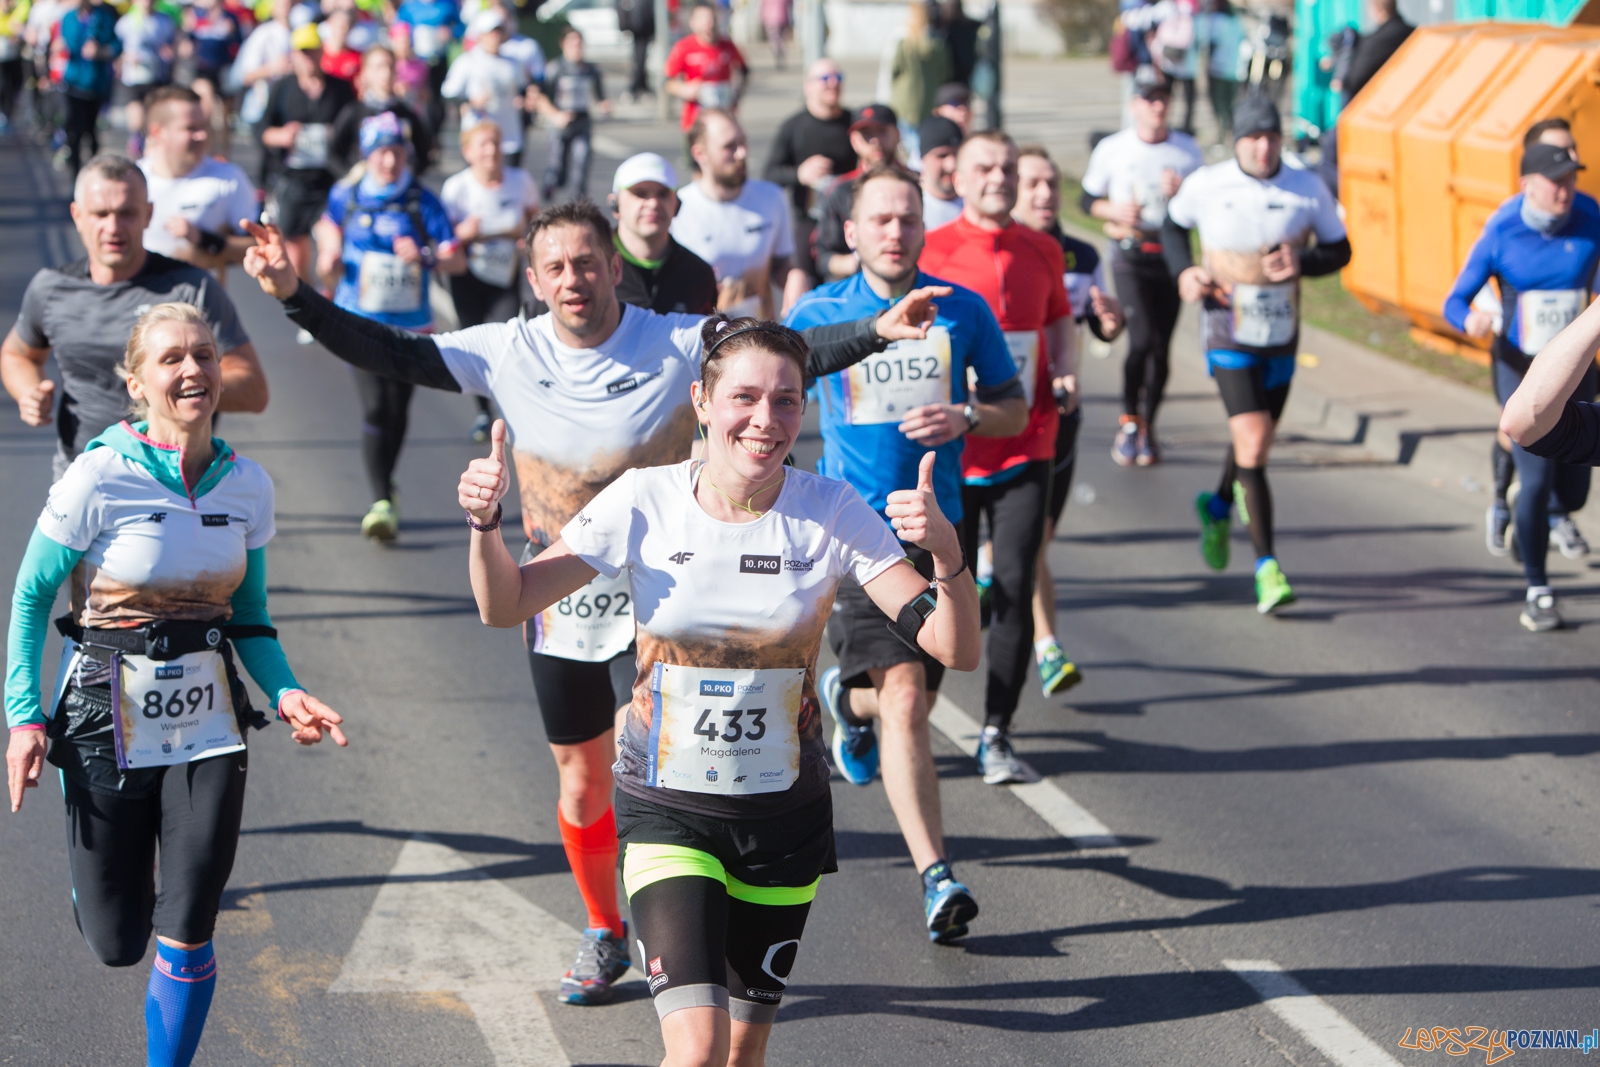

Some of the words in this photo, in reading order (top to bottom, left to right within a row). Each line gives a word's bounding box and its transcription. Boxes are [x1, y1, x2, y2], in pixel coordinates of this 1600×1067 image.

[861, 356, 940, 384] 10152
[668, 551, 695, 565] 4F
[744, 559, 756, 569] 10.
[757, 560, 778, 570] PKO
[558, 591, 630, 618] 8692
[167, 667, 182, 676] PKO
[703, 684, 714, 692] 10.
[714, 685, 732, 693] PKO
[142, 682, 214, 719] 8691
[693, 707, 767, 743] 433
[700, 747, 761, 758] Magdalena
[733, 775, 748, 783] 4F
